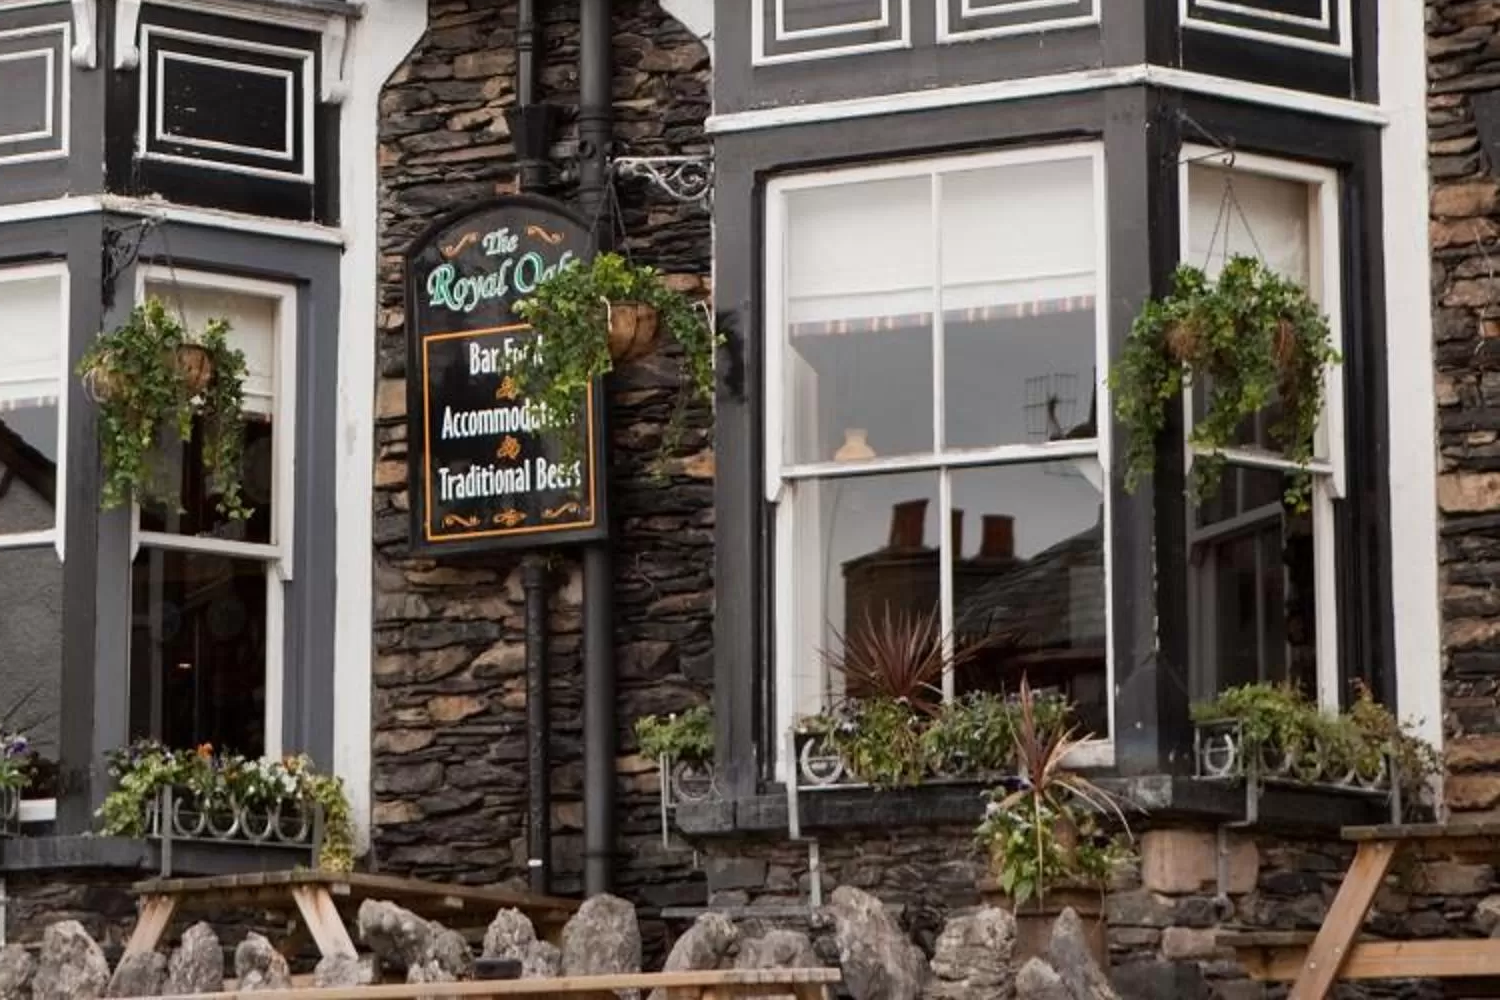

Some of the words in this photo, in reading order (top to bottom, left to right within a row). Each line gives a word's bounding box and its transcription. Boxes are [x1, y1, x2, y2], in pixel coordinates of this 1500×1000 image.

[482, 227, 519, 256] The
[427, 257, 513, 313] Royal
[469, 342, 499, 376] Bar
[441, 398, 577, 441] Accommodat
[438, 459, 530, 501] Traditional
